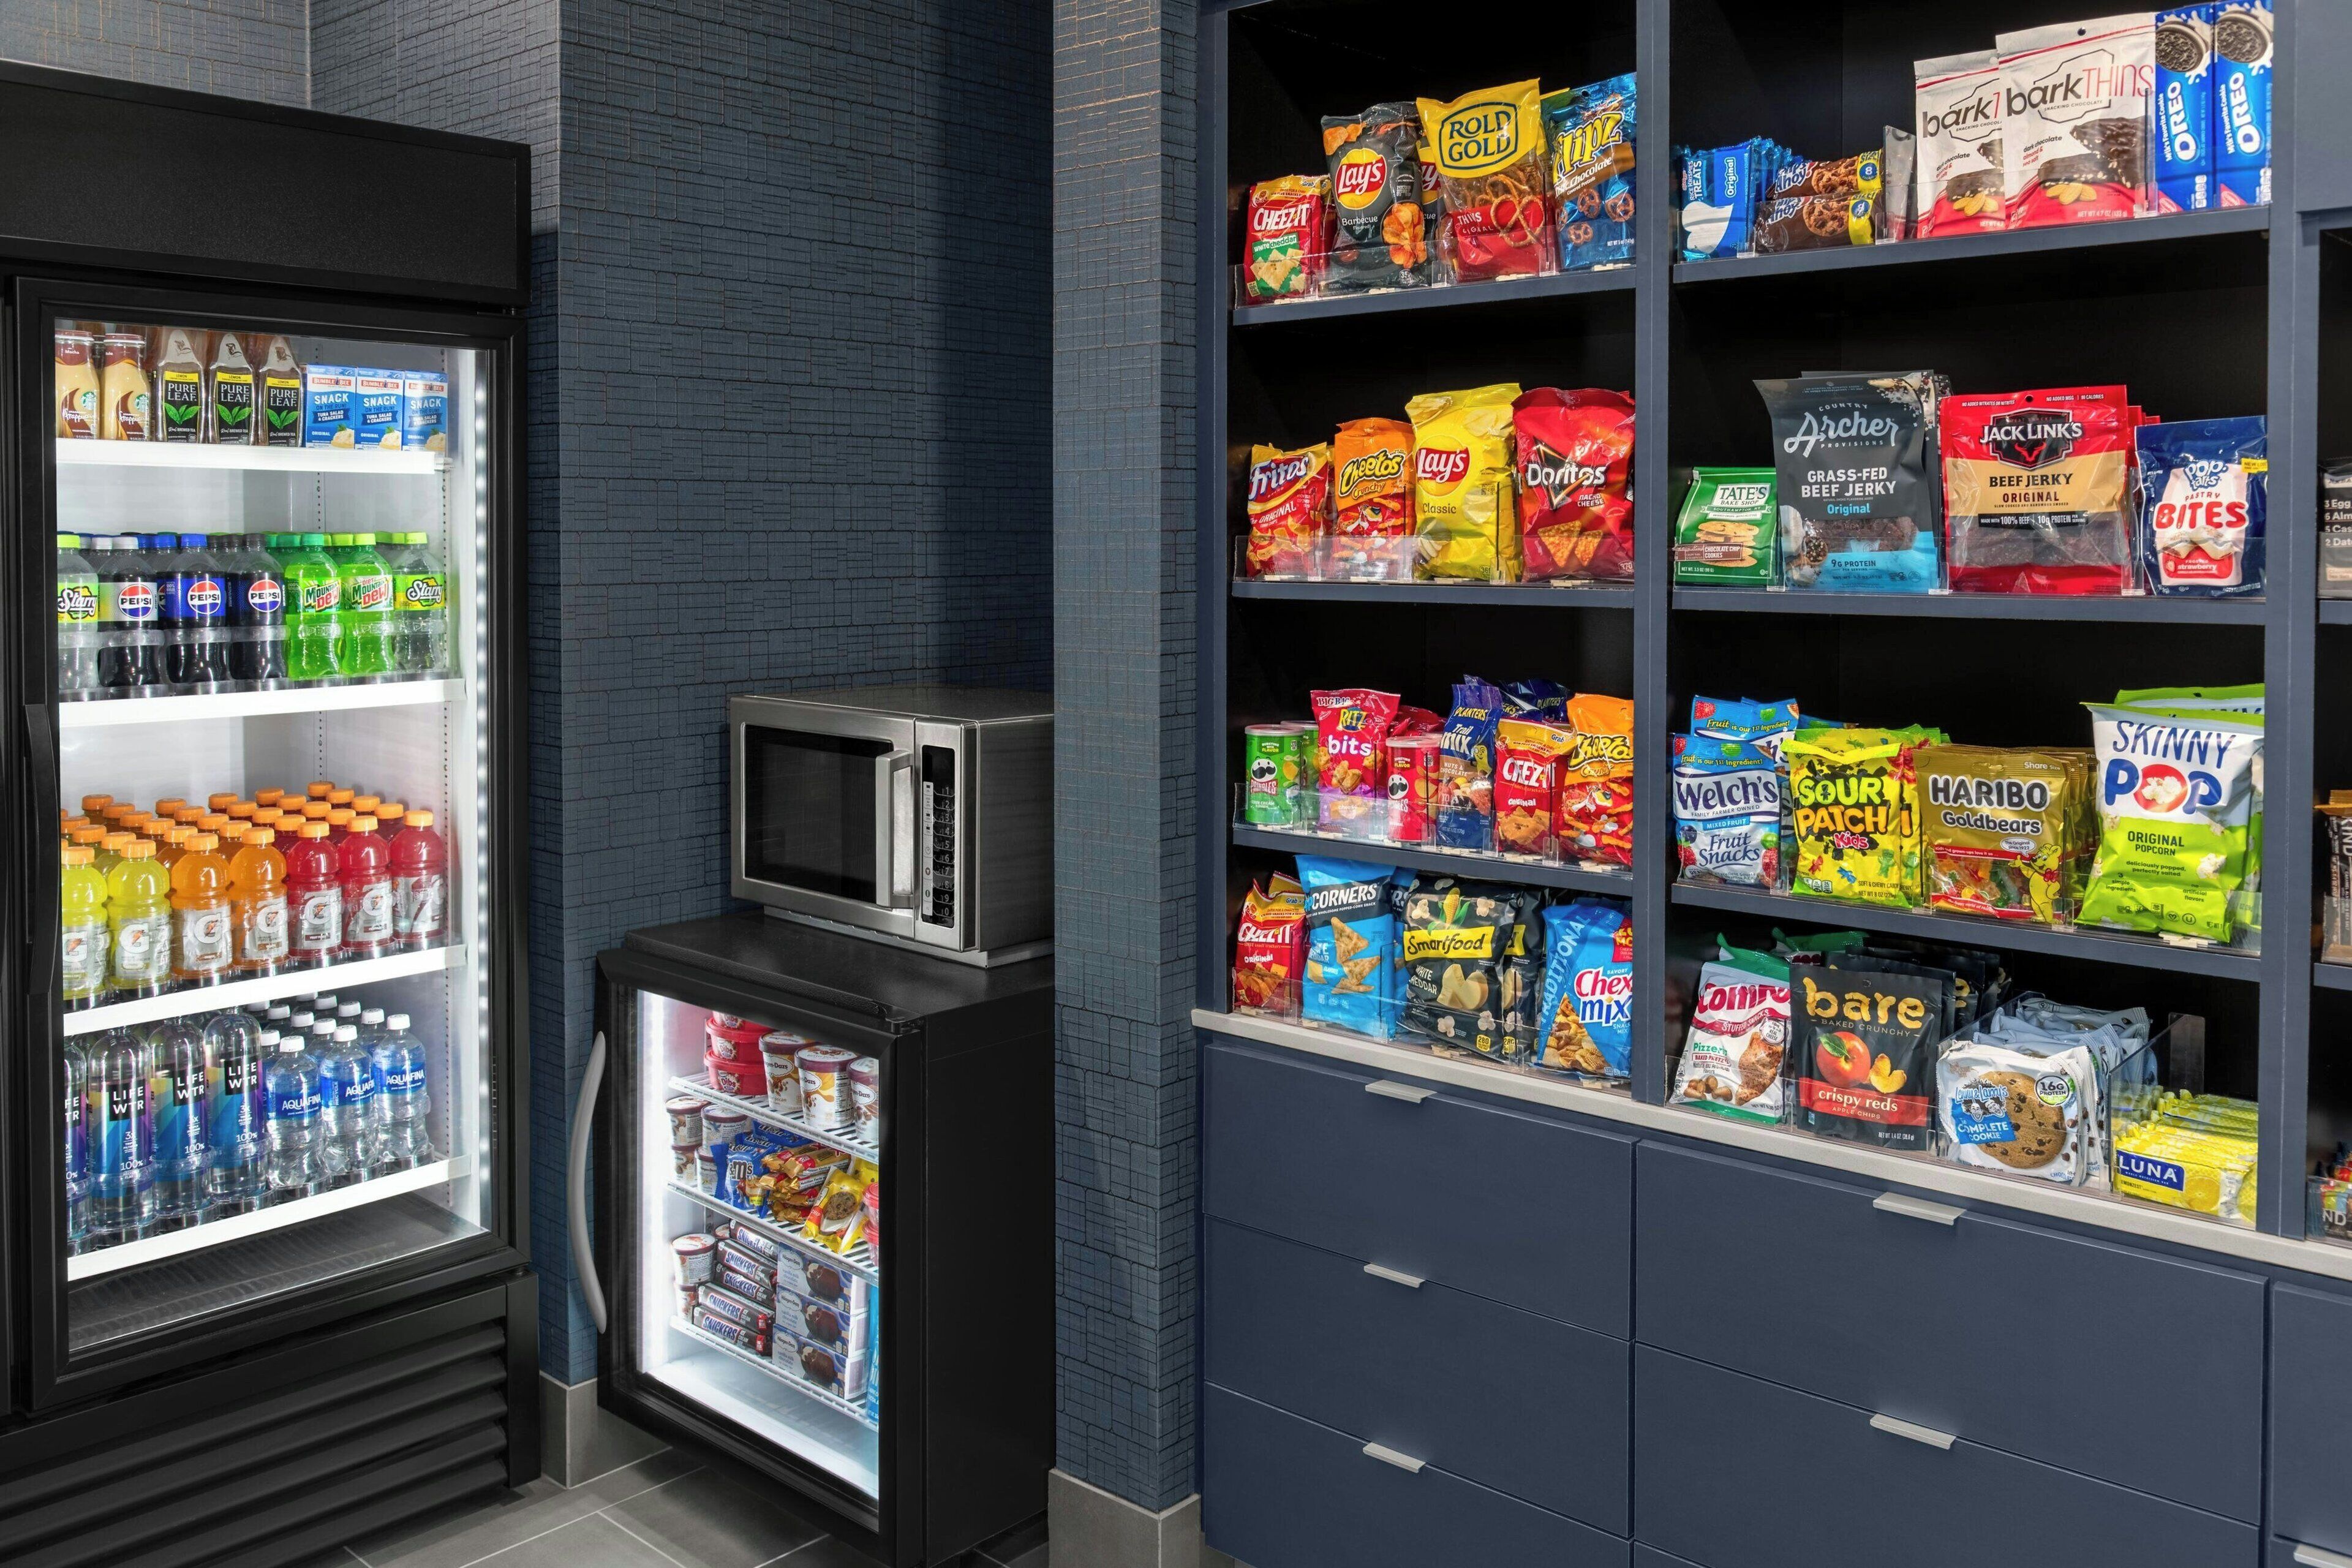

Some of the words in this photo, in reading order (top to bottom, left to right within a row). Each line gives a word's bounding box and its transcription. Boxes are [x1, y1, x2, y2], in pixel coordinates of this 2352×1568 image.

[2229, 72, 2261, 154] OREO
[1449, 110, 1512, 140] ROLD
[2167, 81, 2197, 162] OREO
[1448, 134, 1511, 162] GOLD
[2024, 143, 2034, 153] dark
[2034, 135, 2062, 146] chocolate
[1338, 160, 1383, 195] Lay's
[1727, 158, 1736, 197] Original
[1341, 216, 1378, 227] Barbecue
[1270, 235, 1297, 248] cheddar
[168, 383, 196, 393] PURE
[221, 384, 249, 394] PURE
[270, 388, 297, 398] PURE
[168, 392, 197, 402] LEAF
[221, 393, 249, 402] LEAF
[270, 397, 297, 407] LEAF
[314, 394, 349, 404] SNACK
[363, 396, 396, 407] SNACK
[410, 399, 441, 409] SNACK
[1819, 402, 1868, 412] COUNTRY
[1784, 411, 1899, 458] Archer
[1980, 426, 2026, 443] JACK
[2026, 422, 2082, 440] LINK'S
[1820, 440, 1884, 448] PROVISIONS
[1340, 451, 1404, 496] Cheetos
[1417, 449, 1466, 483] Lay's
[1248, 456, 1308, 500] Fritos
[1528, 464, 1606, 487] Doritos
[1807, 467, 1887, 483] GRASS-FED
[1989, 475, 2023, 488] BEEF
[2025, 473, 2073, 487] JERKY
[1719, 486, 1767, 500] TATE'S
[1801, 483, 1839, 497] BEEF
[1844, 481, 1896, 497] JERKY
[2185, 491, 2220, 502] PASTRY
[1577, 498, 1604, 507] CHEESE
[2002, 492, 2060, 503] ORIGINAL
[2331, 499, 2351, 509] Egg
[1259, 501, 1297, 524] ORIGINAL
[1423, 502, 1457, 514] Classic
[1827, 503, 1871, 516] Original
[2155, 501, 2248, 530] BITES
[2000, 516, 2018, 525] 100%
[2177, 562, 2217, 571] strawberry
[1317, 697, 1333, 706] BIG
[1339, 708, 1369, 730] RITZ
[1453, 707, 1488, 721] PLANTERS
[1452, 723, 1474, 735] Trail
[1706, 719, 1730, 729] Fruit
[1327, 735, 1372, 756] bits
[2113, 720, 2236, 769] SKINNY
[1681, 755, 1695, 765] Fruit
[2024, 761, 2048, 770] Share
[1250, 780, 1278, 795] PRINGLES
[1799, 777, 1883, 806] SOUR
[1931, 775, 2049, 811] HARIBO
[2105, 758, 2223, 815] POP
[1675, 777, 1778, 812] Welch's
[1727, 818, 1747, 827] FRUIT
[1796, 804, 1889, 835] PATCH
[1942, 810, 2043, 834] Goldbears
[1709, 833, 1751, 851] Fruit
[1834, 834, 1869, 850] Kids
[2127, 831, 2185, 848] ORIGINAL
[1698, 846, 1760, 867] Snacks
[2135, 843, 2176, 856] POPCORN
[2126, 860, 2160, 869] deliciously
[2132, 867, 2158, 876] perfectly
[2105, 884, 2136, 893] ingredients
[2182, 888, 2207, 897] artificial
[1408, 932, 1486, 957] Smartfood
[1415, 964, 1433, 981] WHITE
[1575, 970, 1632, 998] Chex
[1803, 976, 1926, 1029] bare
[1581, 998, 1631, 1025] mix
[1747, 1009, 1770, 1026] SNACKS
[1821, 1019, 1853, 1030] BAKED
[1858, 1023, 1911, 1038] CRUNCHY
[228, 1062, 257, 1077] LIFE
[386, 1069, 425, 1085] AQUAFINA
[177, 1071, 204, 1087] LIFE
[228, 1075, 257, 1089] WTR
[720, 1078, 736, 1087] Dibs
[2041, 1082, 2064, 1091] 16G
[113, 1086, 144, 1101] LIFE
[177, 1086, 205, 1100] WTR
[1818, 1088, 1862, 1110] crispy
[1865, 1096, 1898, 1112] reds
[113, 1101, 145, 1115] WTR
[282, 1093, 321, 1110] AQUAFINA
[1832, 1106, 1855, 1116] APPLE
[1857, 1109, 1881, 1120] CHIPS
[1958, 1121, 2009, 1133] COMPLETE
[236, 1133, 257, 1143] 100%
[120, 1160, 143, 1170] 100%
[2119, 1155, 2177, 1183] LUNA
[726, 1251, 757, 1276] SNICKERS
[724, 1273, 757, 1298] SNICKERS
[709, 1294, 741, 1320] SNICKERS
[703, 1317, 737, 1341] SNICKERS
